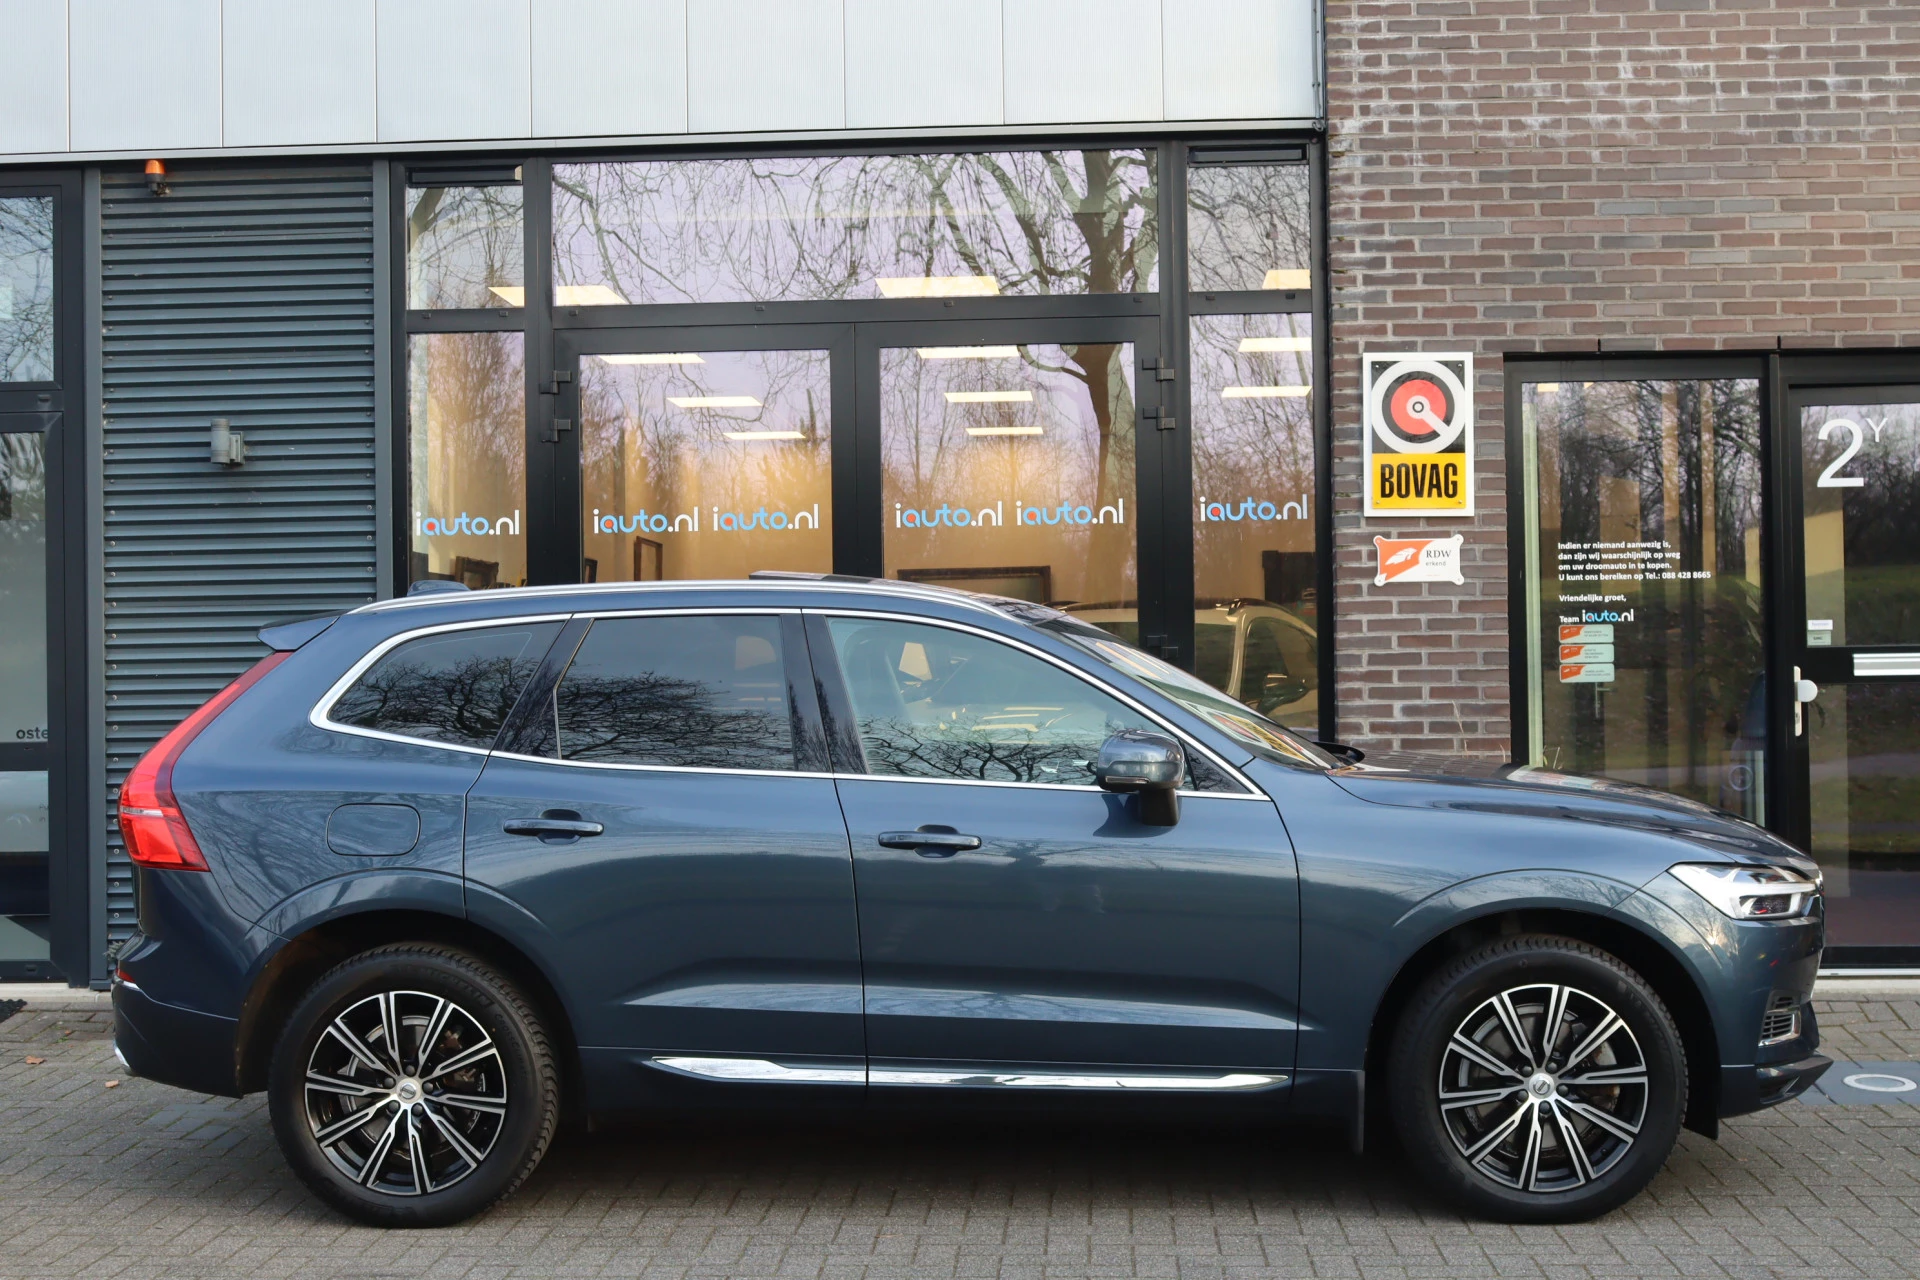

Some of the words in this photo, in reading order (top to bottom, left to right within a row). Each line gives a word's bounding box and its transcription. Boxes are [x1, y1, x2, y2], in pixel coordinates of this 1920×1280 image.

[1380, 462, 1458, 498] BOVAG
[713, 503, 819, 532] iauto.nl
[895, 500, 1003, 528] iauto.nl
[1016, 498, 1124, 526] iauto.nl
[1199, 493, 1308, 522] iauto.nl
[416, 509, 520, 536] iauto.nl
[593, 506, 699, 534] iauto.nl
[1426, 550, 1451, 558] RDW
[1558, 542, 1582, 550] Indien
[1592, 541, 1625, 549] niemand
[1626, 541, 1661, 549] aanwezig
[1558, 552, 1573, 560] dan
[1573, 552, 1587, 561] zijn
[1588, 552, 1600, 561] wij
[1601, 551, 1652, 560] waarschijnlijk
[1664, 552, 1681, 560] weg
[1566, 573, 1584, 581] kunt
[1600, 572, 1633, 580] bereiken
[1633, 573, 1644, 581] op
[1661, 571, 1676, 579] 088
[1677, 571, 1692, 579] 428
[1692, 570, 1712, 579] 8665
[1585, 562, 1627, 570] droomauto
[1646, 561, 1672, 570] kopen.
[1558, 594, 1603, 603] Vriendelijke
[1604, 594, 1627, 603] groet,
[1559, 615, 1580, 623] Team
[1581, 608, 1634, 623] iauto.nl
